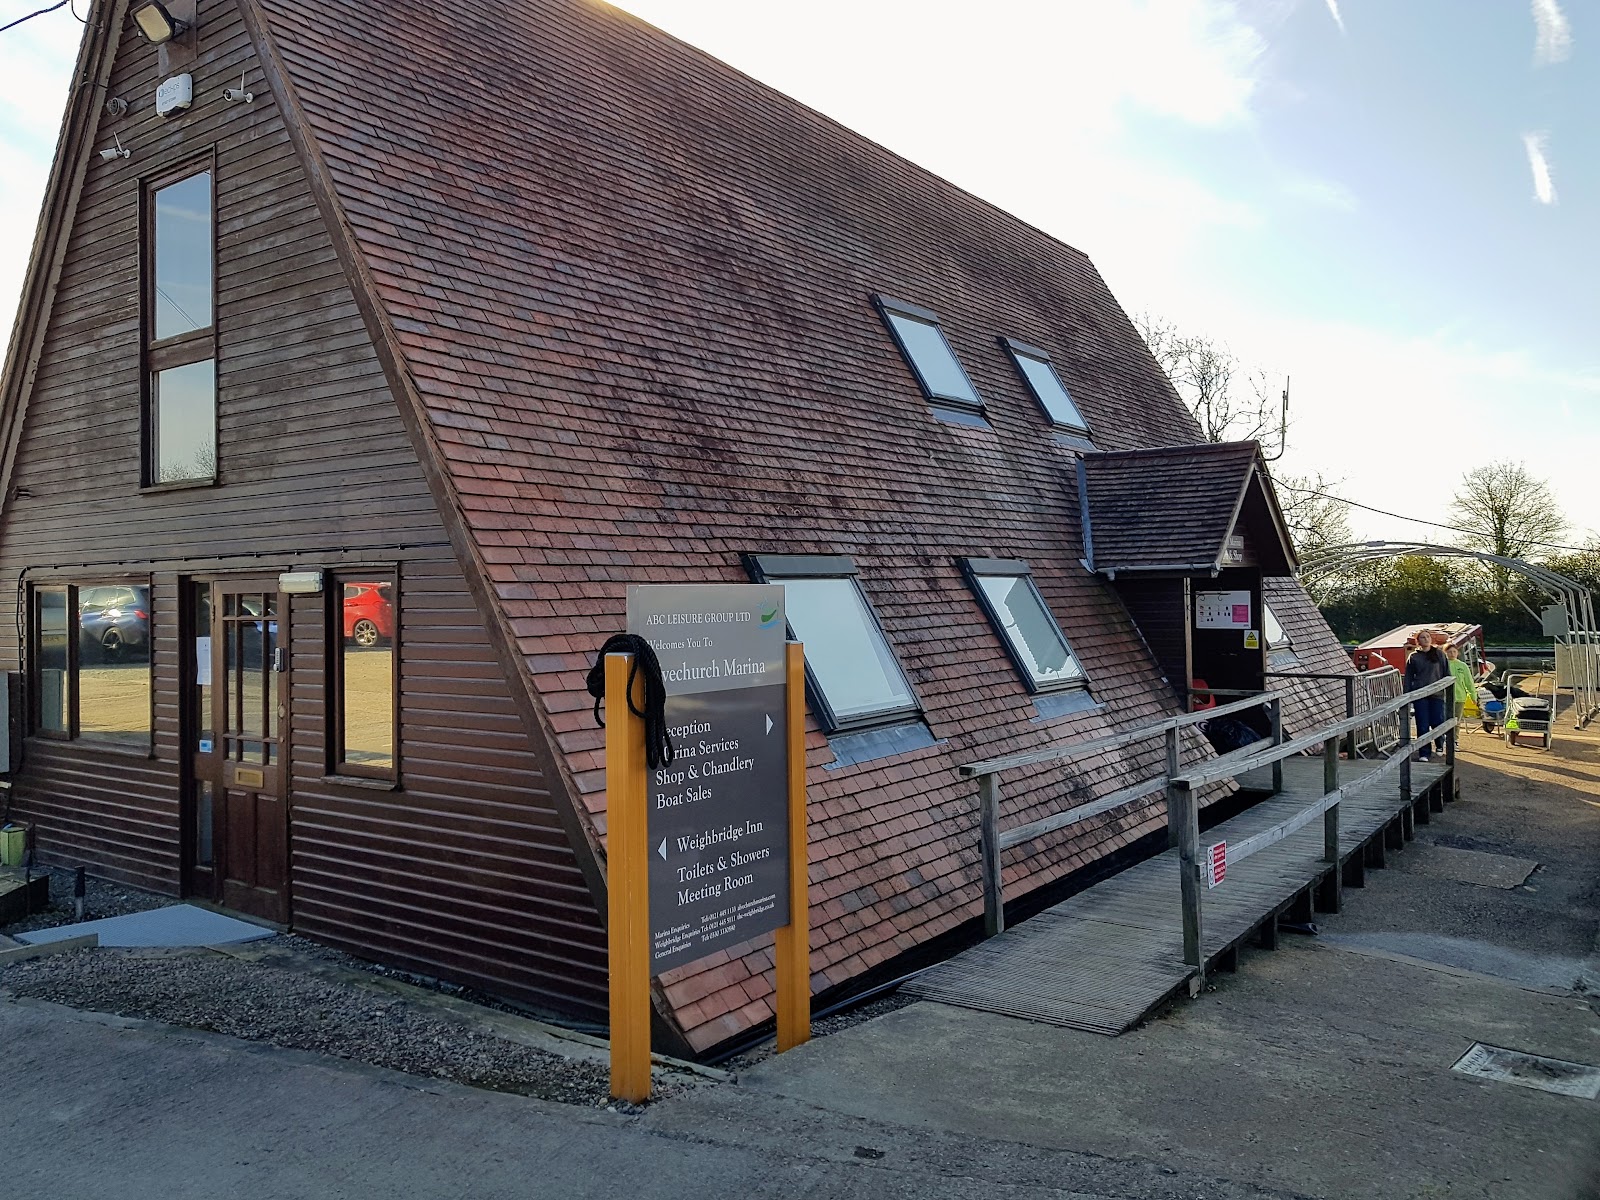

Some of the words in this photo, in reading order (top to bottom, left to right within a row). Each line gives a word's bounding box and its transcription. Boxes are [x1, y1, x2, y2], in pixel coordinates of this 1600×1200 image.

[646, 614, 666, 625] ABC
[667, 613, 703, 624] LEISURE
[704, 612, 734, 623] GROUP
[735, 611, 751, 622] LTD
[647, 640, 685, 650] Welcomes
[686, 638, 701, 648] You
[702, 637, 713, 647] To
[660, 659, 720, 682] vechurch
[723, 657, 766, 677] Marina
[663, 719, 711, 739] eception
[699, 738, 739, 755] Services
[655, 769, 685, 786] Shop
[687, 764, 699, 780] &
[702, 756, 755, 777] Chandlery
[656, 792, 683, 810] Boat
[686, 785, 712, 803] Sales
[677, 825, 744, 853] Weighbridge
[745, 820, 764, 835] Inn
[677, 862, 714, 883] Toilets
[716, 856, 728, 871] &
[730, 847, 770, 868] Showers
[677, 883, 721, 907] Meeting
[723, 873, 754, 892] Room
